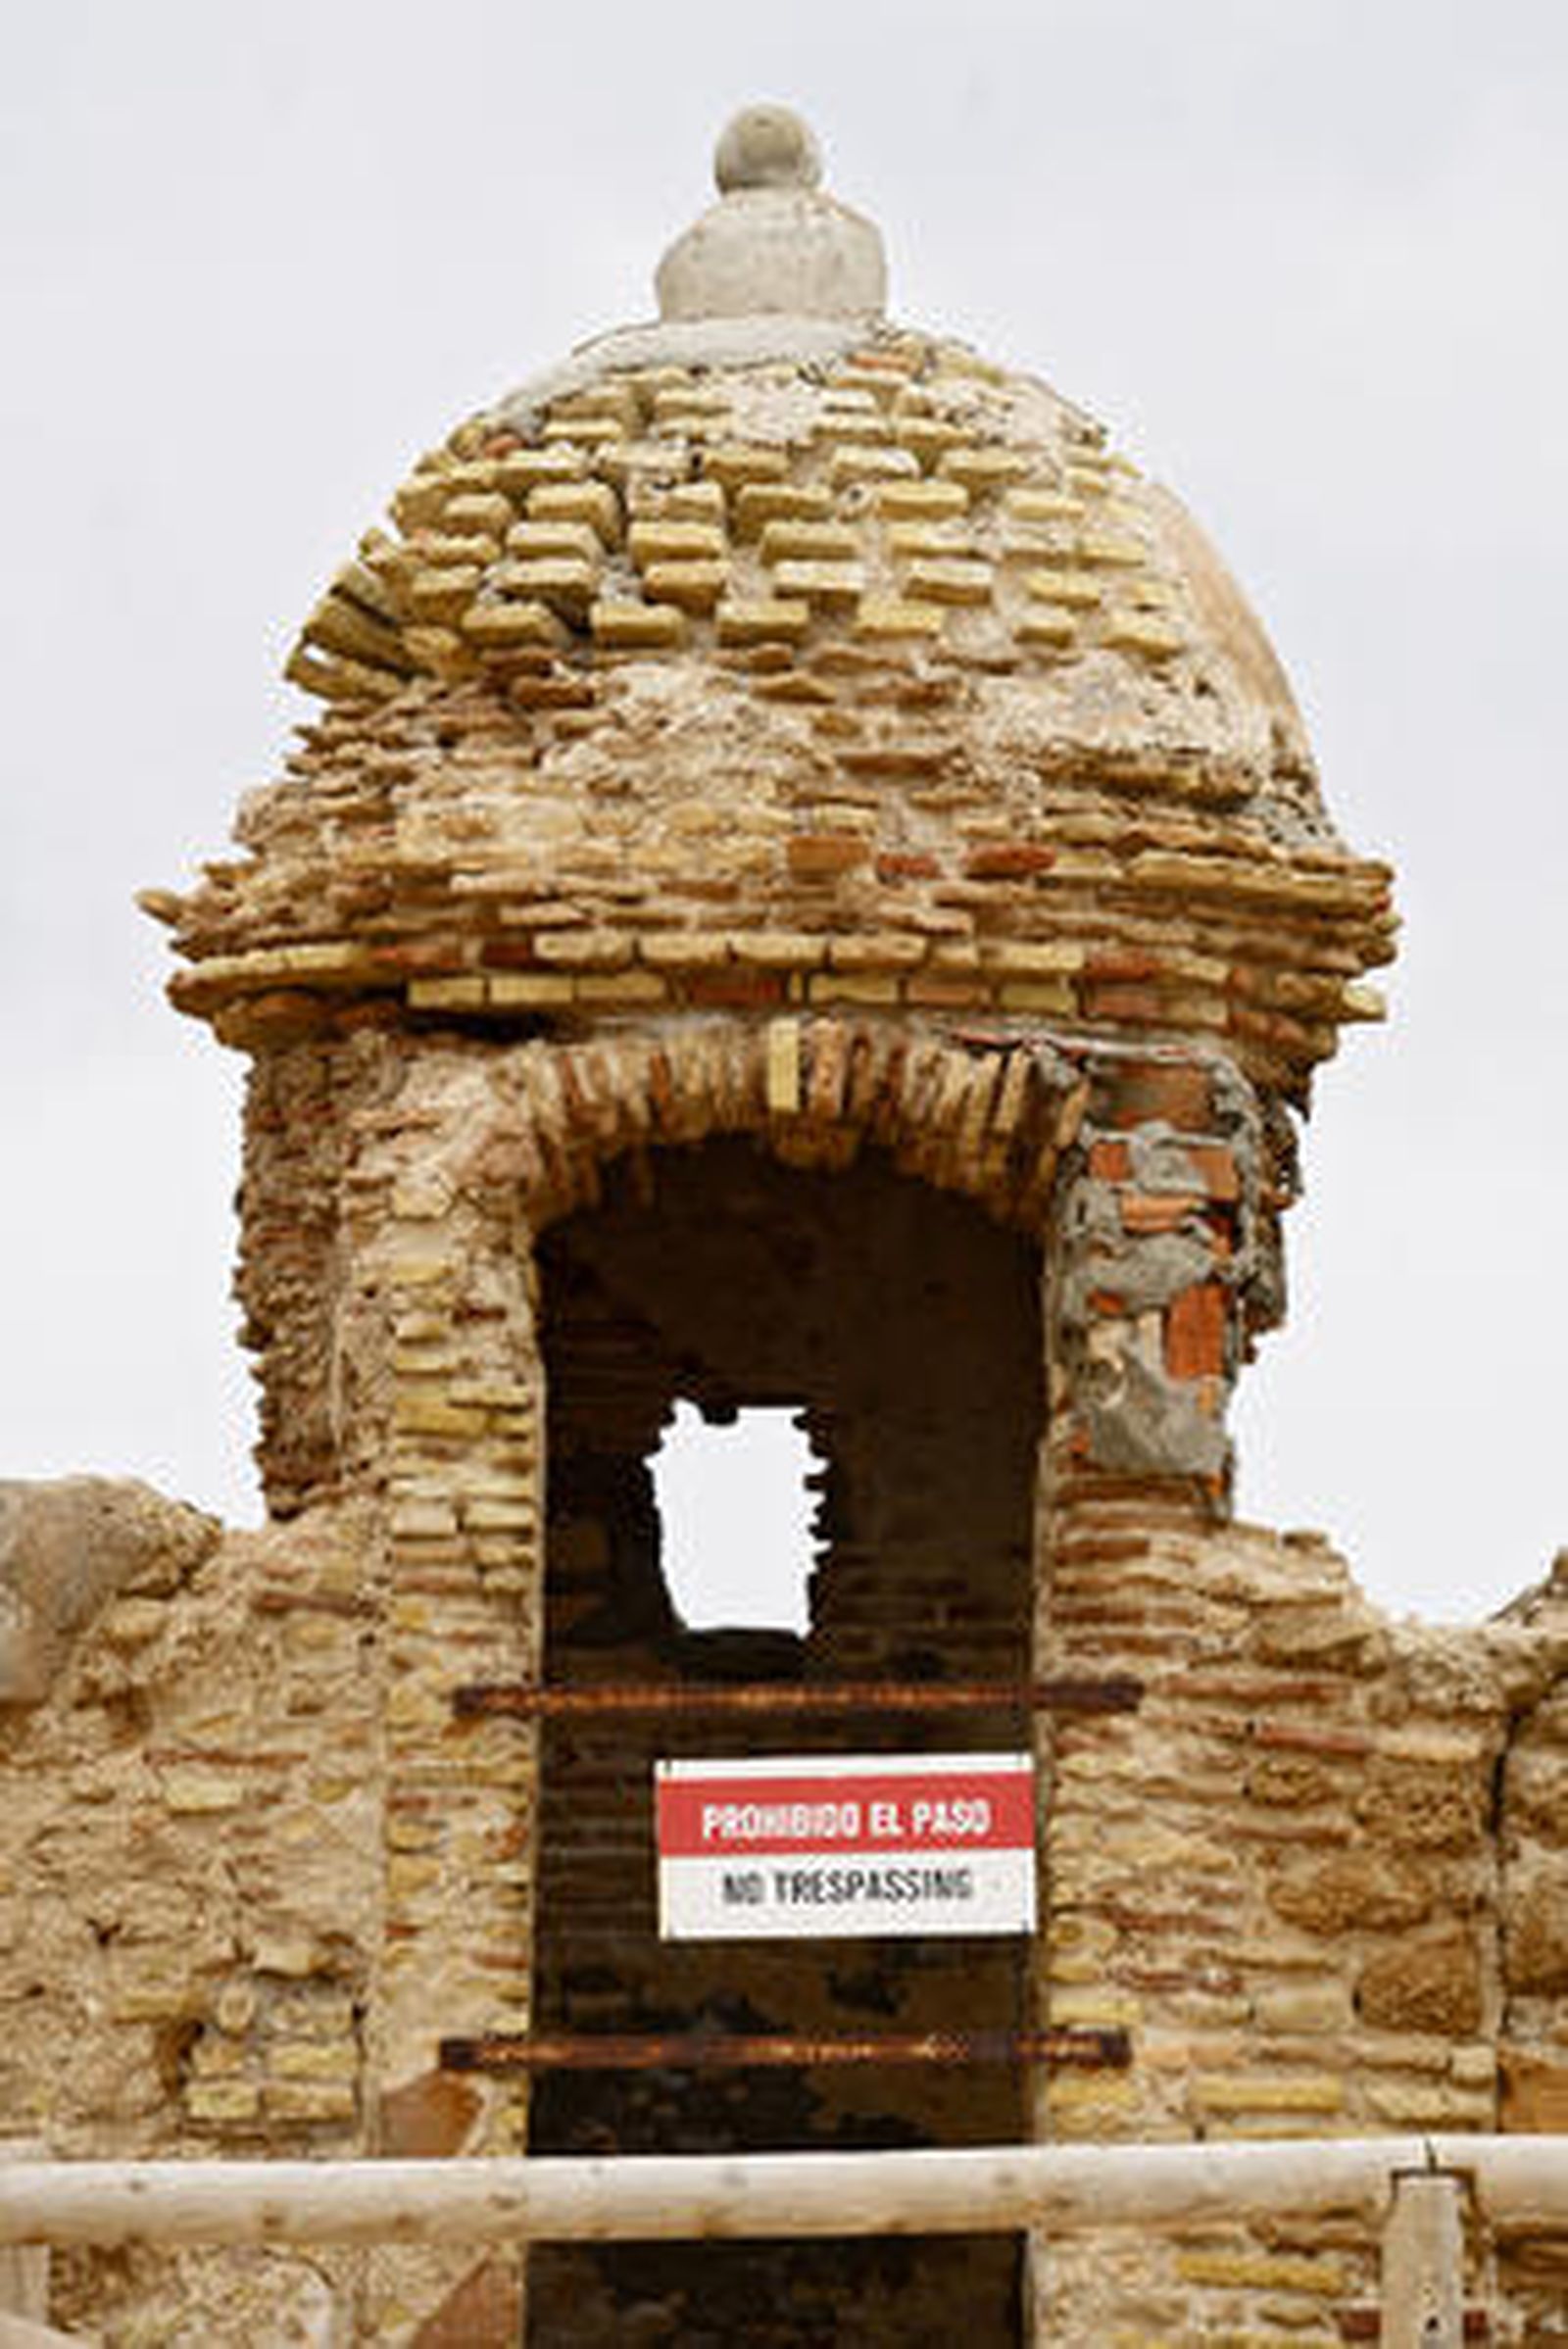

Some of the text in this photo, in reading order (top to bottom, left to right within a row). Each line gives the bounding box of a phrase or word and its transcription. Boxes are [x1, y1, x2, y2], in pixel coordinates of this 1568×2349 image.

[701, 1798, 993, 1840] PROHIBIDO EL PASO
[722, 1868, 975, 1905] NO TRESPASSING
